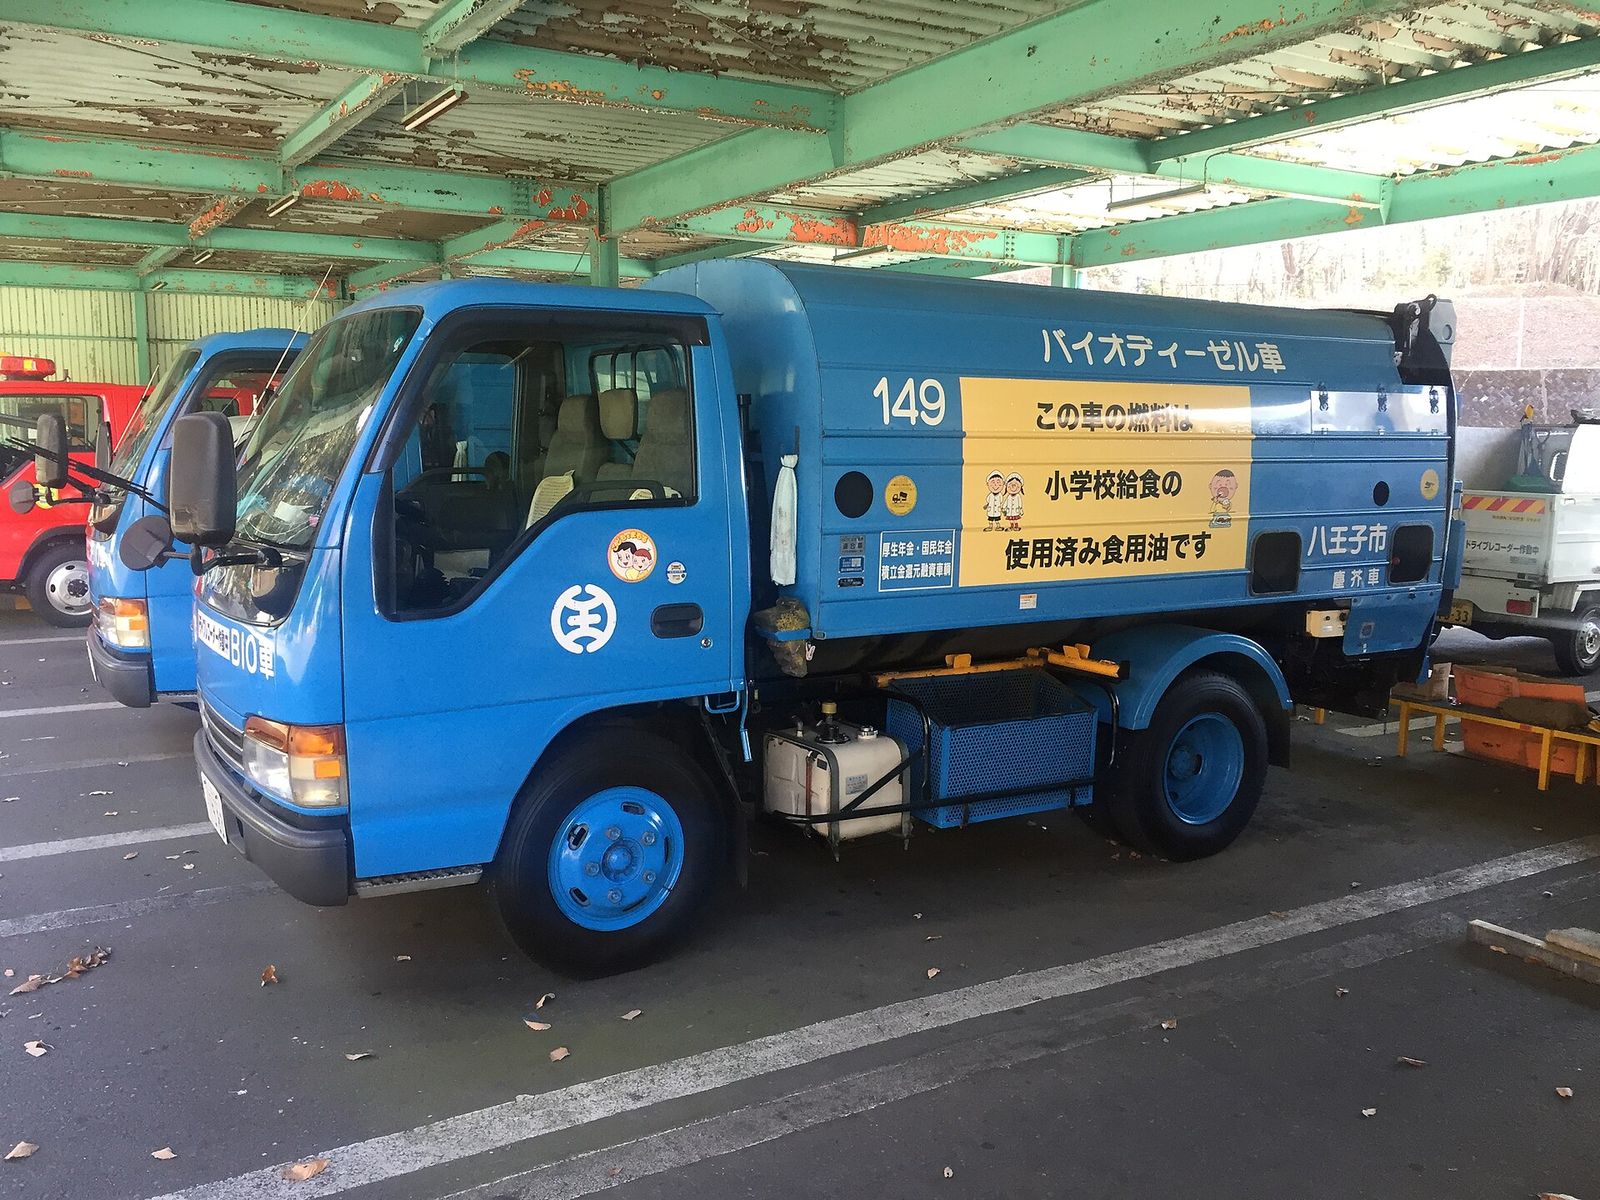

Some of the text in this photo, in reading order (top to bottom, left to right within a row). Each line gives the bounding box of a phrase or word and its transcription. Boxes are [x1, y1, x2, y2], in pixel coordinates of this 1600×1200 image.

[1042, 328, 1286, 373] バイオディーゼル車
[873, 377, 946, 426] 149
[1036, 402, 1193, 432] この車の燃料は
[1045, 469, 1183, 501] 小学校給食の
[1005, 531, 1212, 570] 使用済み食用油です
[1307, 522, 1388, 556] 八王子市
